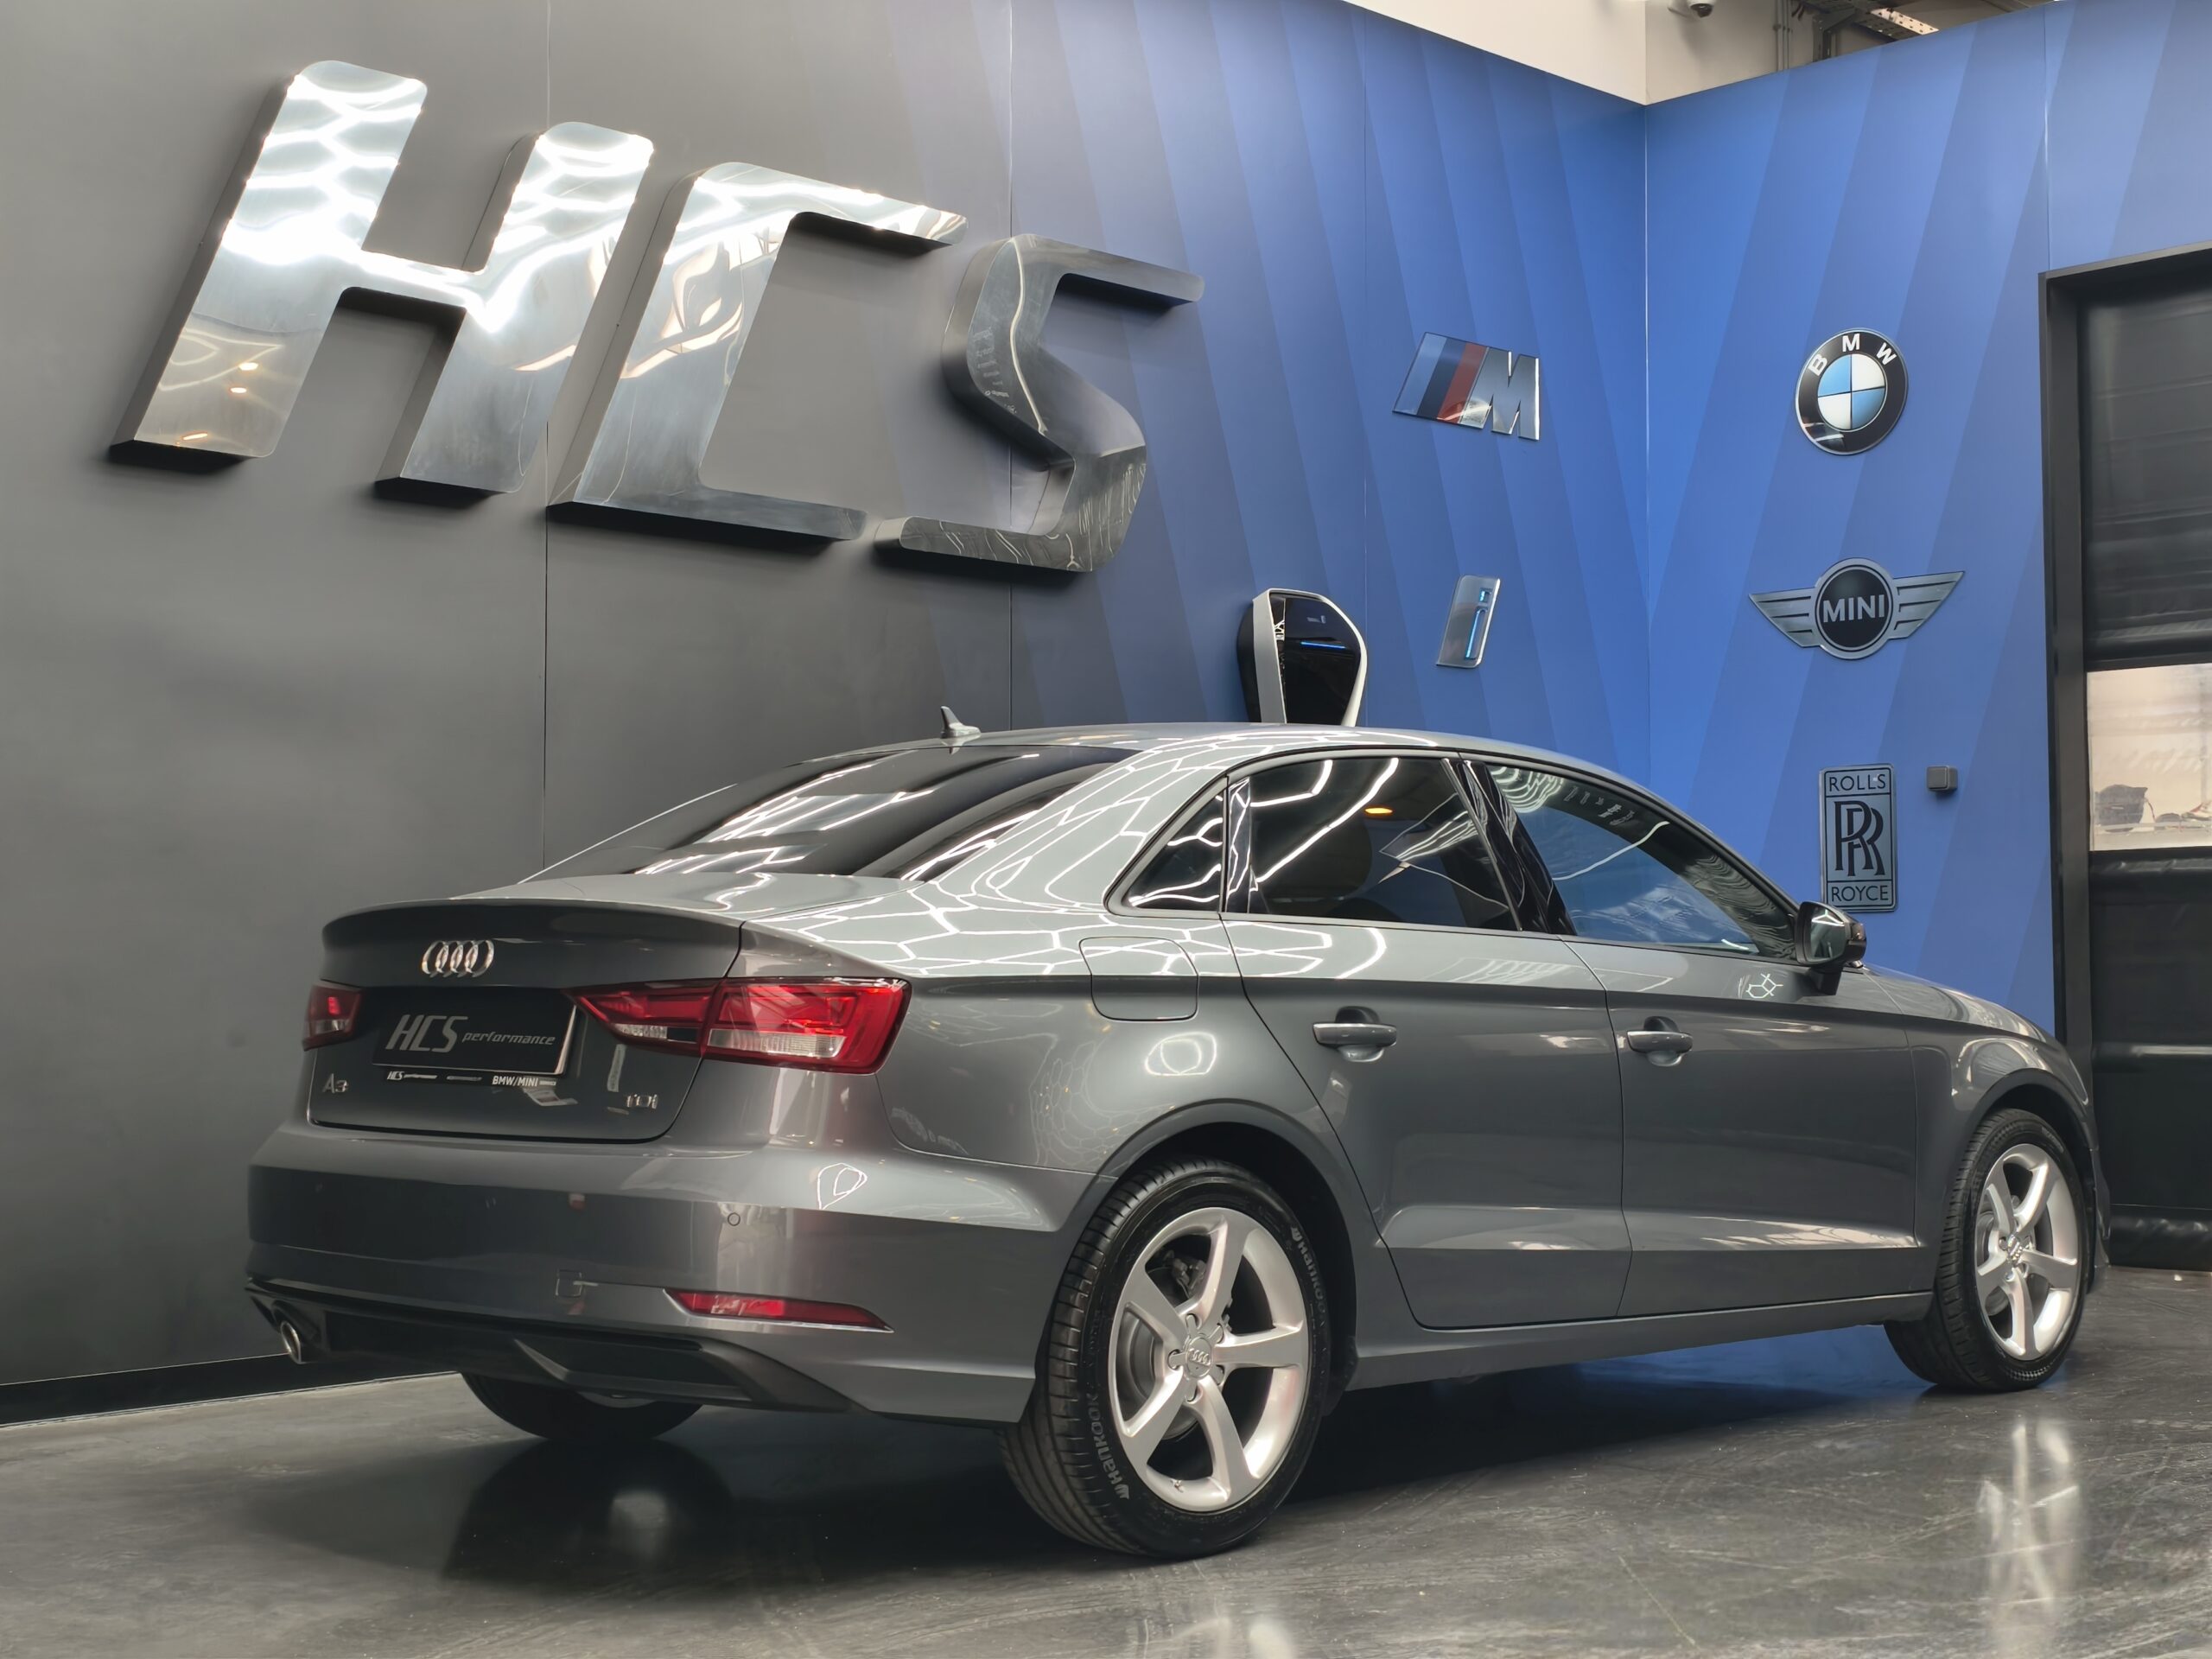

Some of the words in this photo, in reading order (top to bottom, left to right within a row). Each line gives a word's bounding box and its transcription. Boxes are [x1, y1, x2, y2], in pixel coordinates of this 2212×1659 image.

[117, 60, 1205, 574] HCS
[1808, 333, 1897, 377] BMW
[1821, 594, 1885, 623] MINI
[1828, 773, 1886, 792] ROLLS
[1831, 885, 1889, 902] ROYCE
[385, 1014, 468, 1053] HCS
[462, 1031, 556, 1046] performance
[492, 1076, 538, 1087] BMW/MINI
